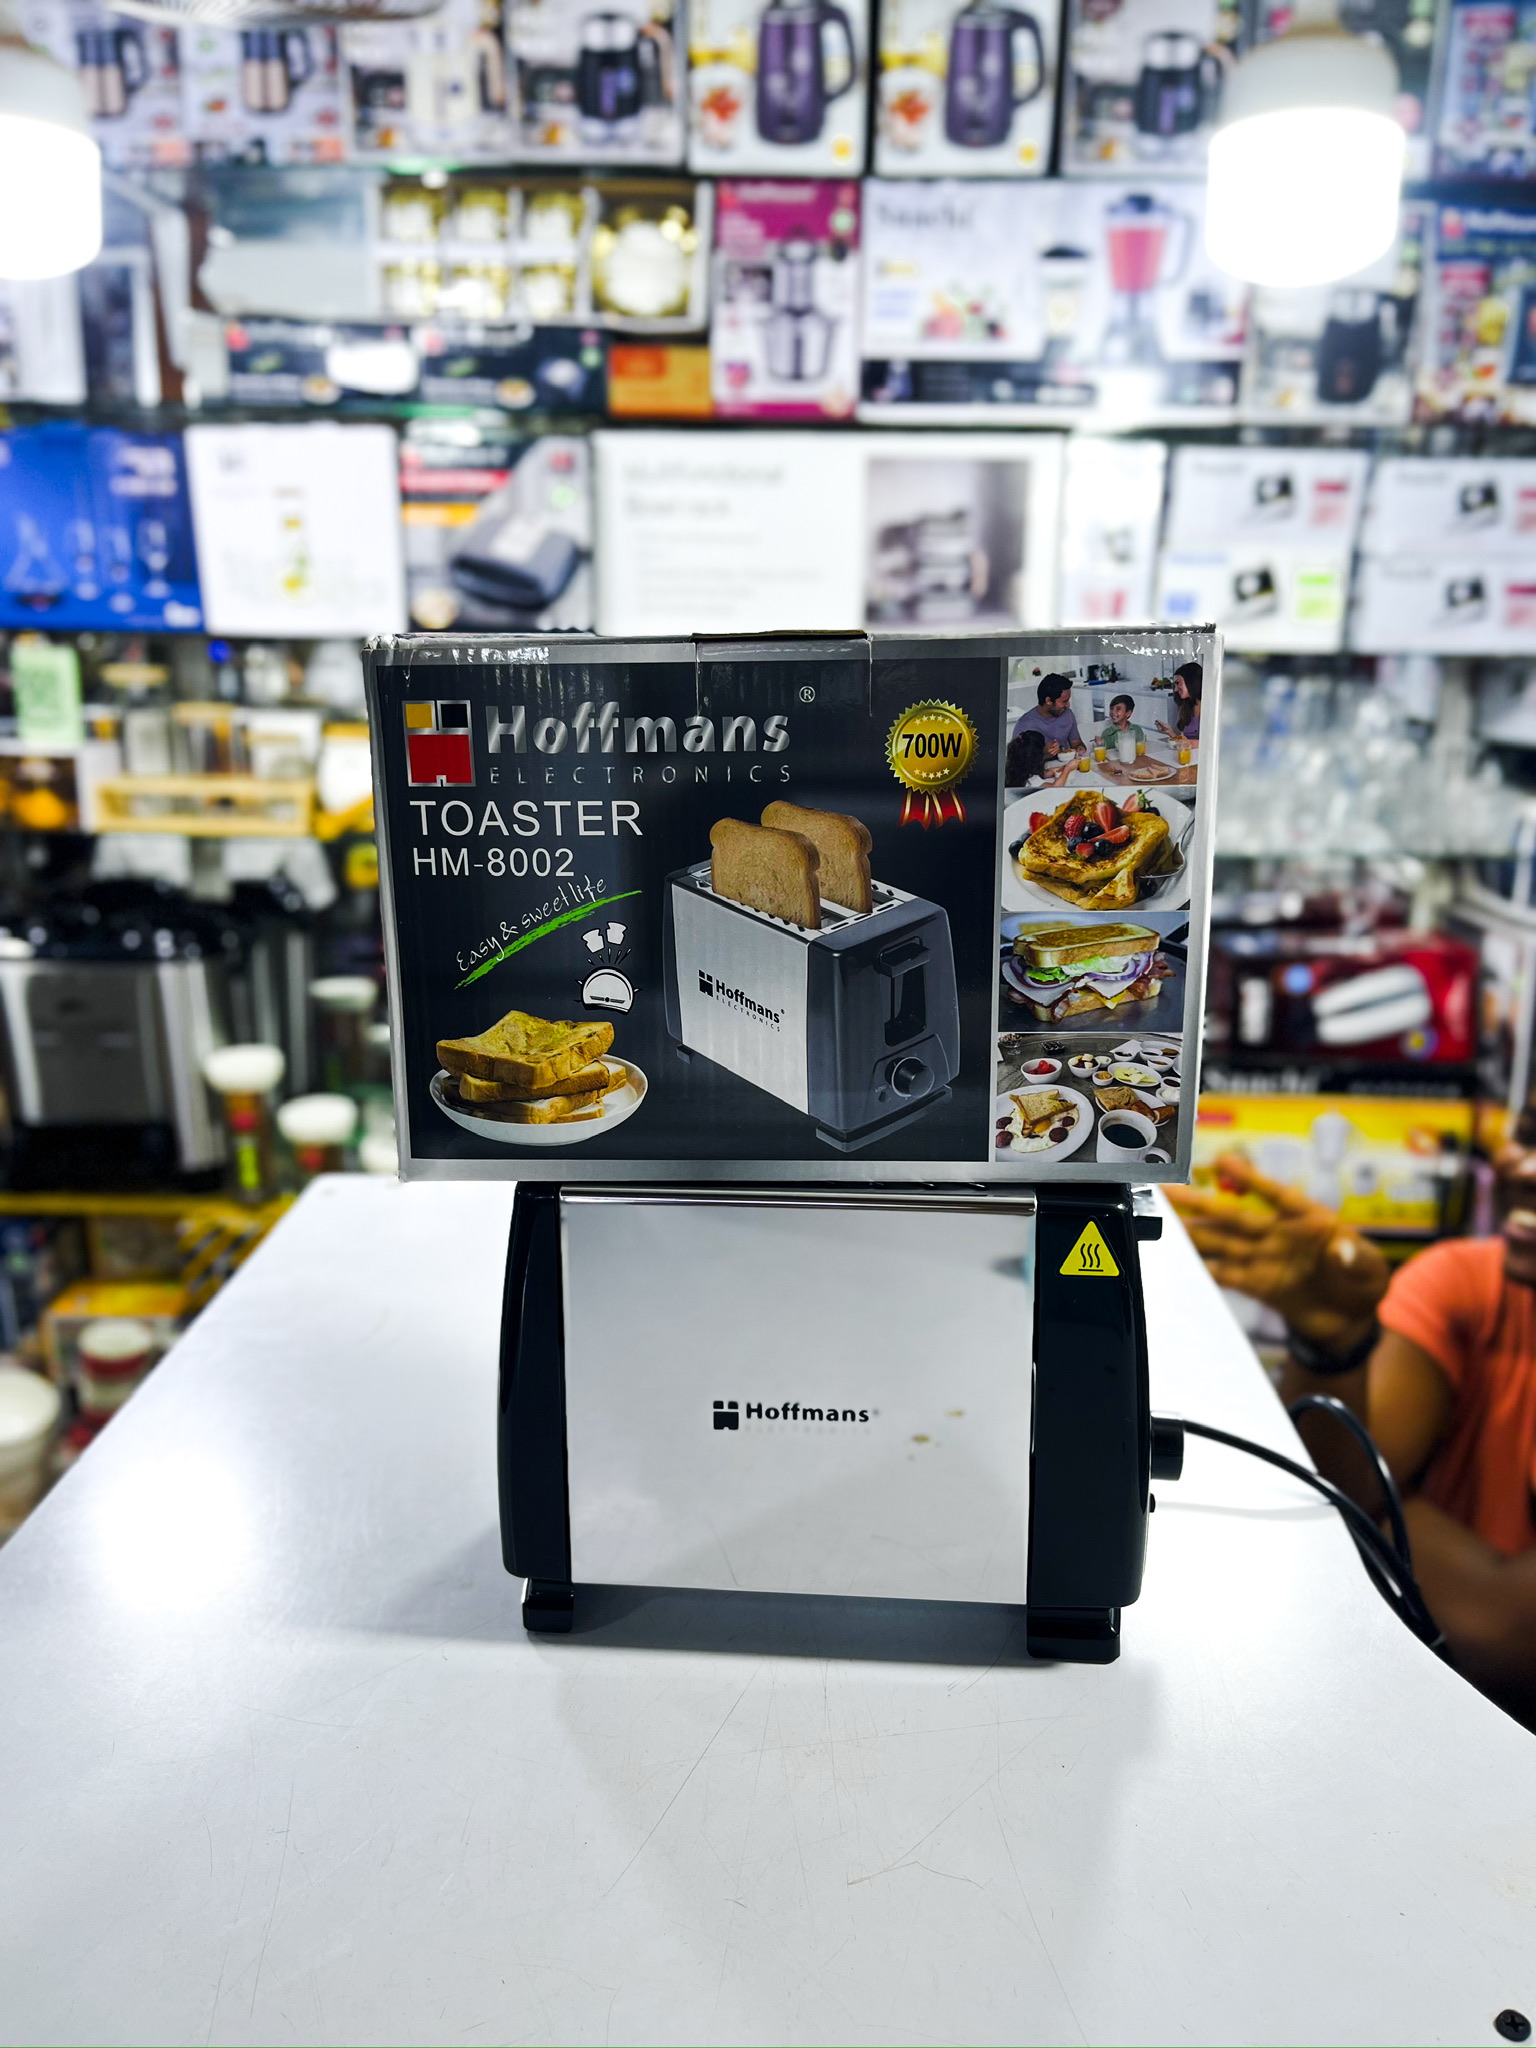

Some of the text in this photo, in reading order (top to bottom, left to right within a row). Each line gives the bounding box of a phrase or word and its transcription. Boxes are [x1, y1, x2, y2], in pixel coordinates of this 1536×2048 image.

[485, 701, 791, 754] Hoffmans
[902, 733, 963, 759] 700W
[490, 764, 792, 784] ELECTRONICS
[409, 800, 644, 837] TOASTER
[413, 847, 575, 878] HM-8002
[456, 874, 607, 971] Easy & sweet life
[715, 978, 780, 1024] Hoffmans
[745, 1402, 870, 1423] Hoffmans
